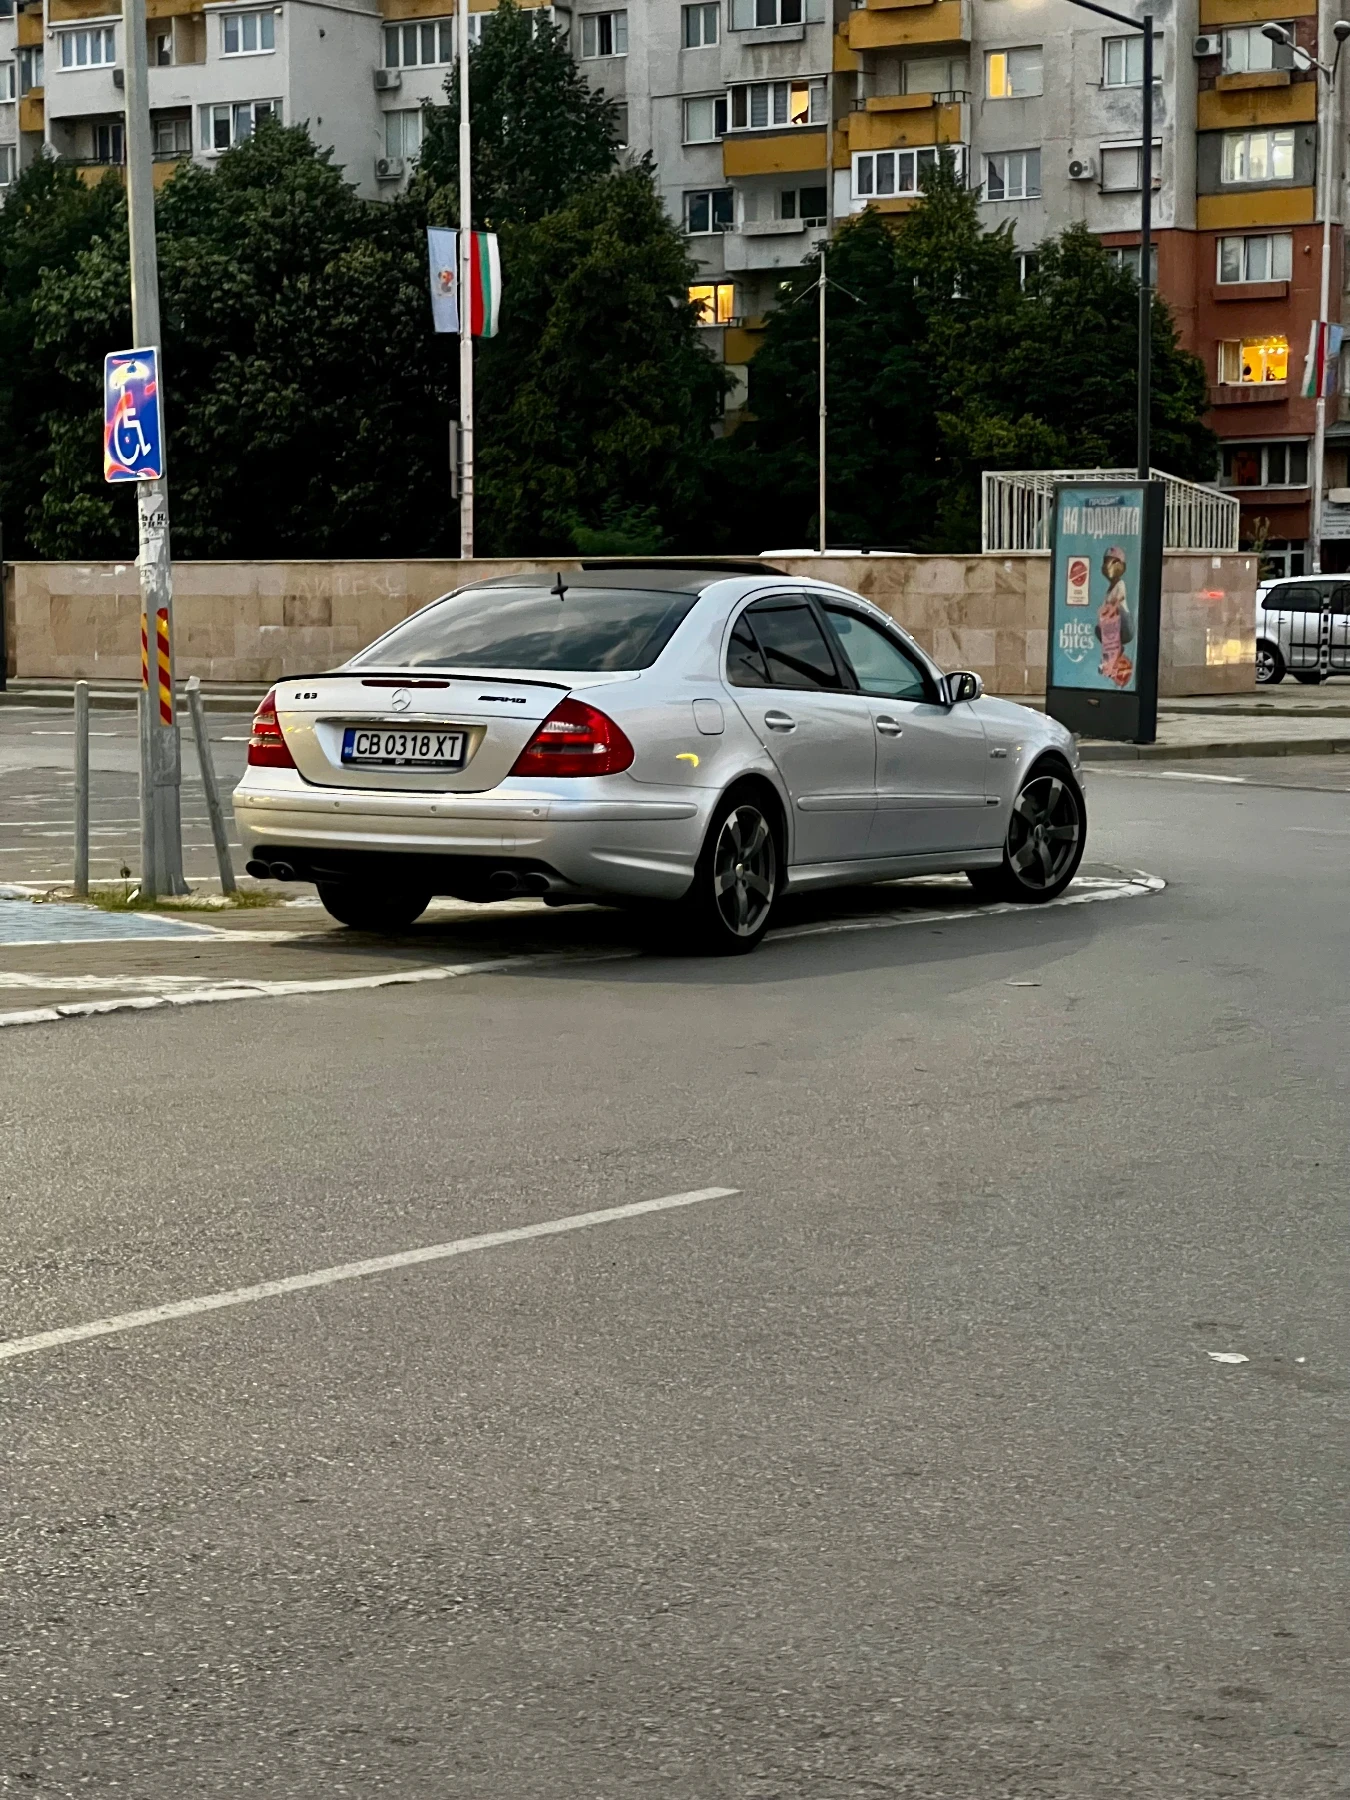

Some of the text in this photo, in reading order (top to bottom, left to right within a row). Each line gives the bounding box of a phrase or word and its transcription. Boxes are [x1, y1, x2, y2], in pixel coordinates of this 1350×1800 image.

[1062, 507, 1140, 540] НА ГОДИНАТА
[1064, 618, 1092, 635] nice
[1059, 629, 1095, 650] bites
[294, 692, 318, 700] E 63
[356, 733, 460, 758] CB 0318 XT
